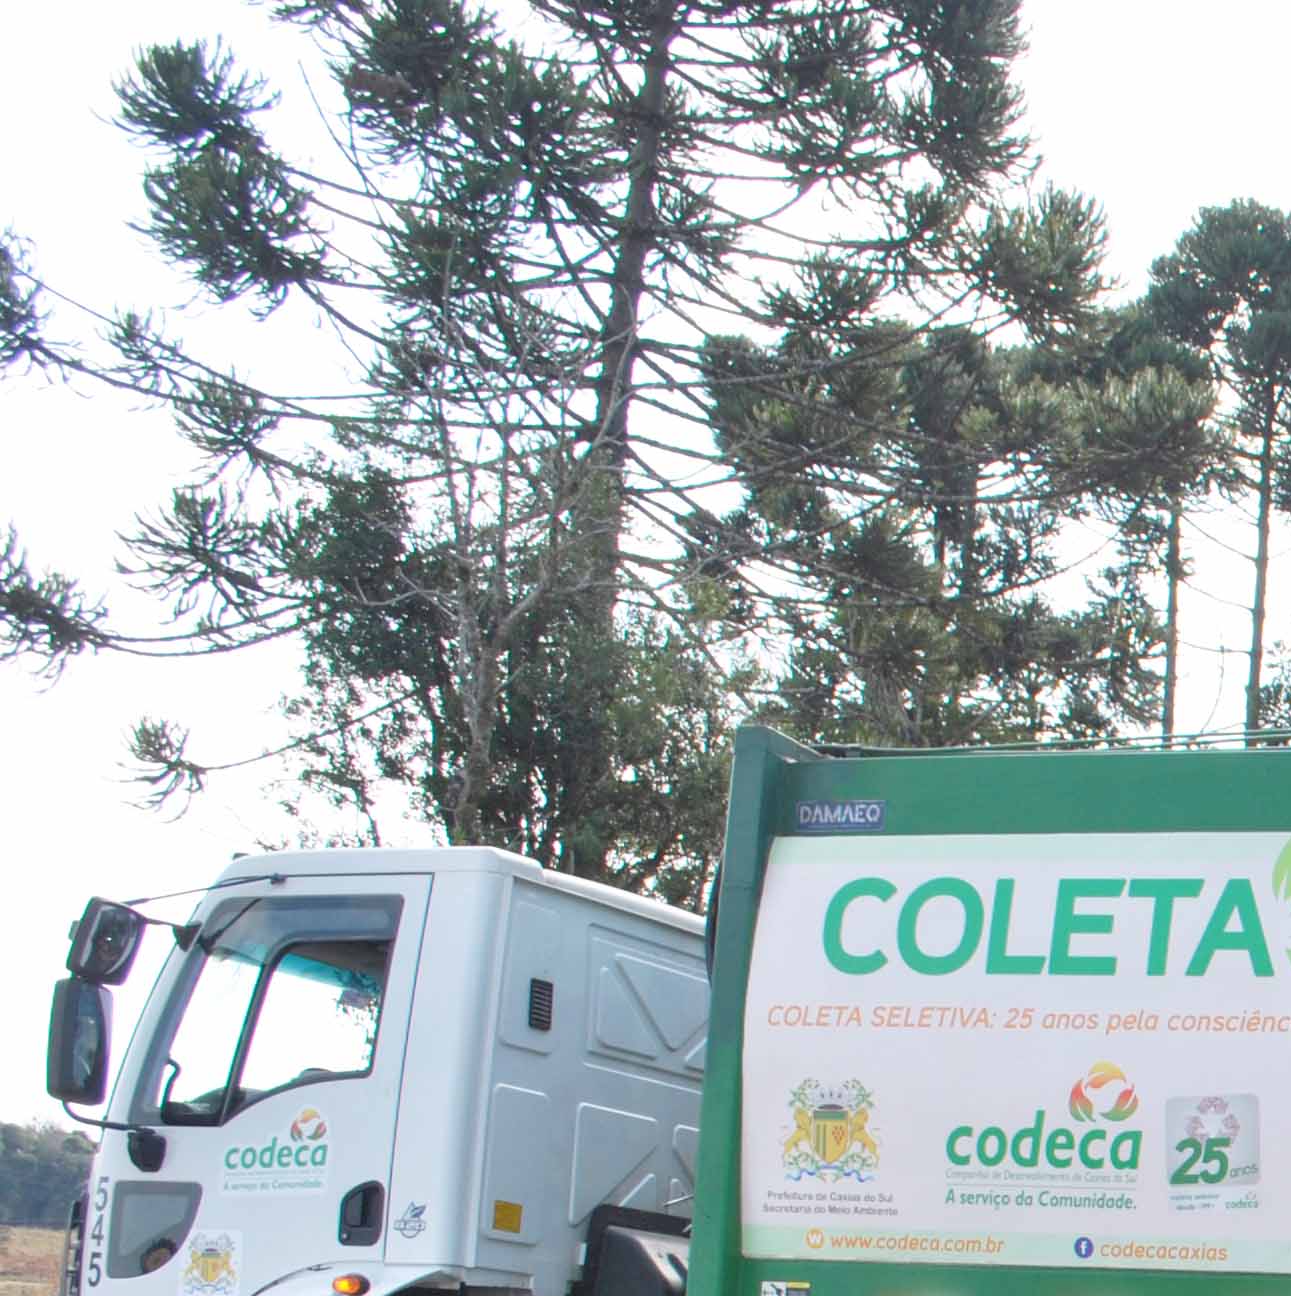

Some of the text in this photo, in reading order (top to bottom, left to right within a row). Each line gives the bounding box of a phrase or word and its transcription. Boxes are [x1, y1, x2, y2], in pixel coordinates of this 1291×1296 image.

[822, 877, 1275, 977] COLETA
[767, 1005, 863, 1027] COLETA
[871, 1006, 997, 1029] SELETIVA:
[1003, 1008, 1035, 1029] 25
[1041, 1012, 1098, 1030] anos
[1105, 1010, 1159, 1035] pela
[224, 1136, 327, 1169] codeca
[946, 1110, 1143, 1170] codeca
[1170, 1137, 1231, 1184] 25
[945, 1188, 955, 1203] A
[960, 1191, 1010, 1209] serviço
[1039, 1191, 1137, 1209] Comunidade.
[830, 1234, 1004, 1253] www.codeca.com.br
[1100, 1239, 1228, 1261] codecacaxias
